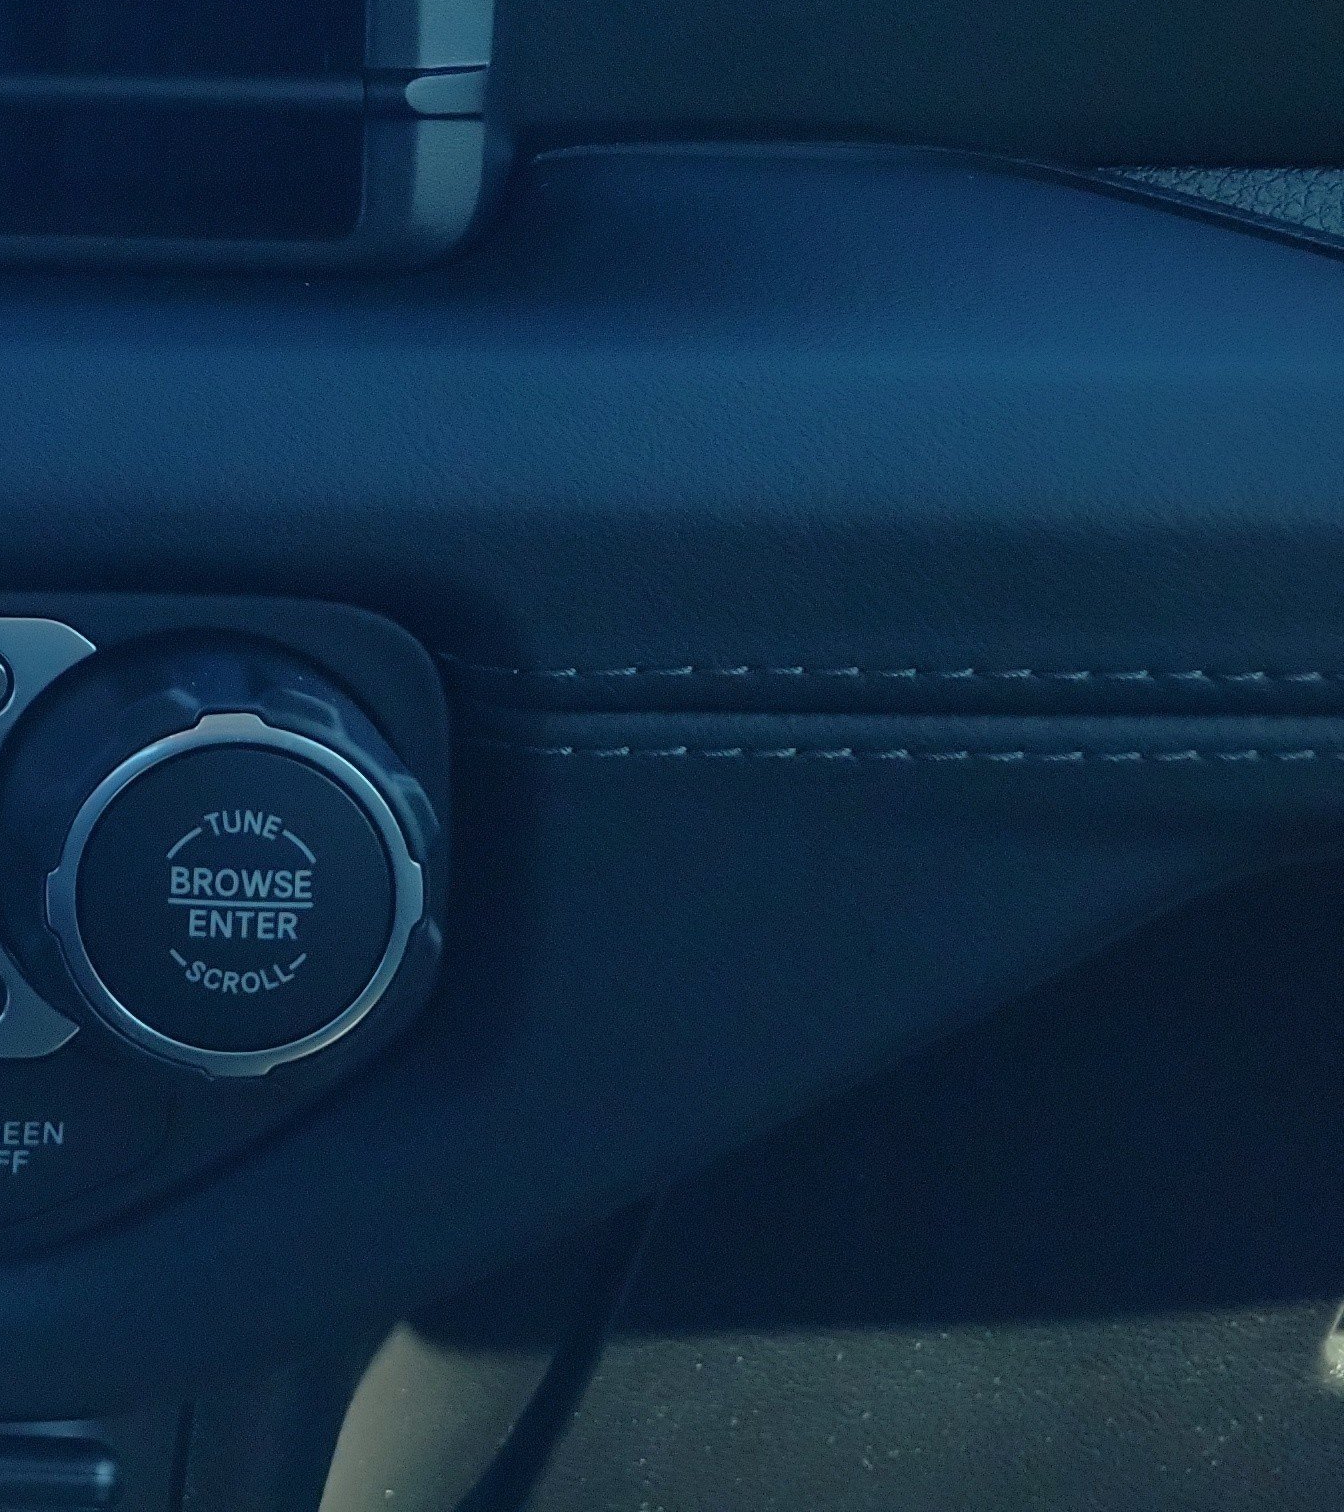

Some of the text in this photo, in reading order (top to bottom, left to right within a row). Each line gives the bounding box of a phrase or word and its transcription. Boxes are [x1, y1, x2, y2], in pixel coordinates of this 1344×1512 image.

[203, 809, 283, 841] TUNE
[167, 865, 314, 901] BROWSE
[187, 908, 299, 941] ENTER
[184, 957, 297, 995] SCROLL
